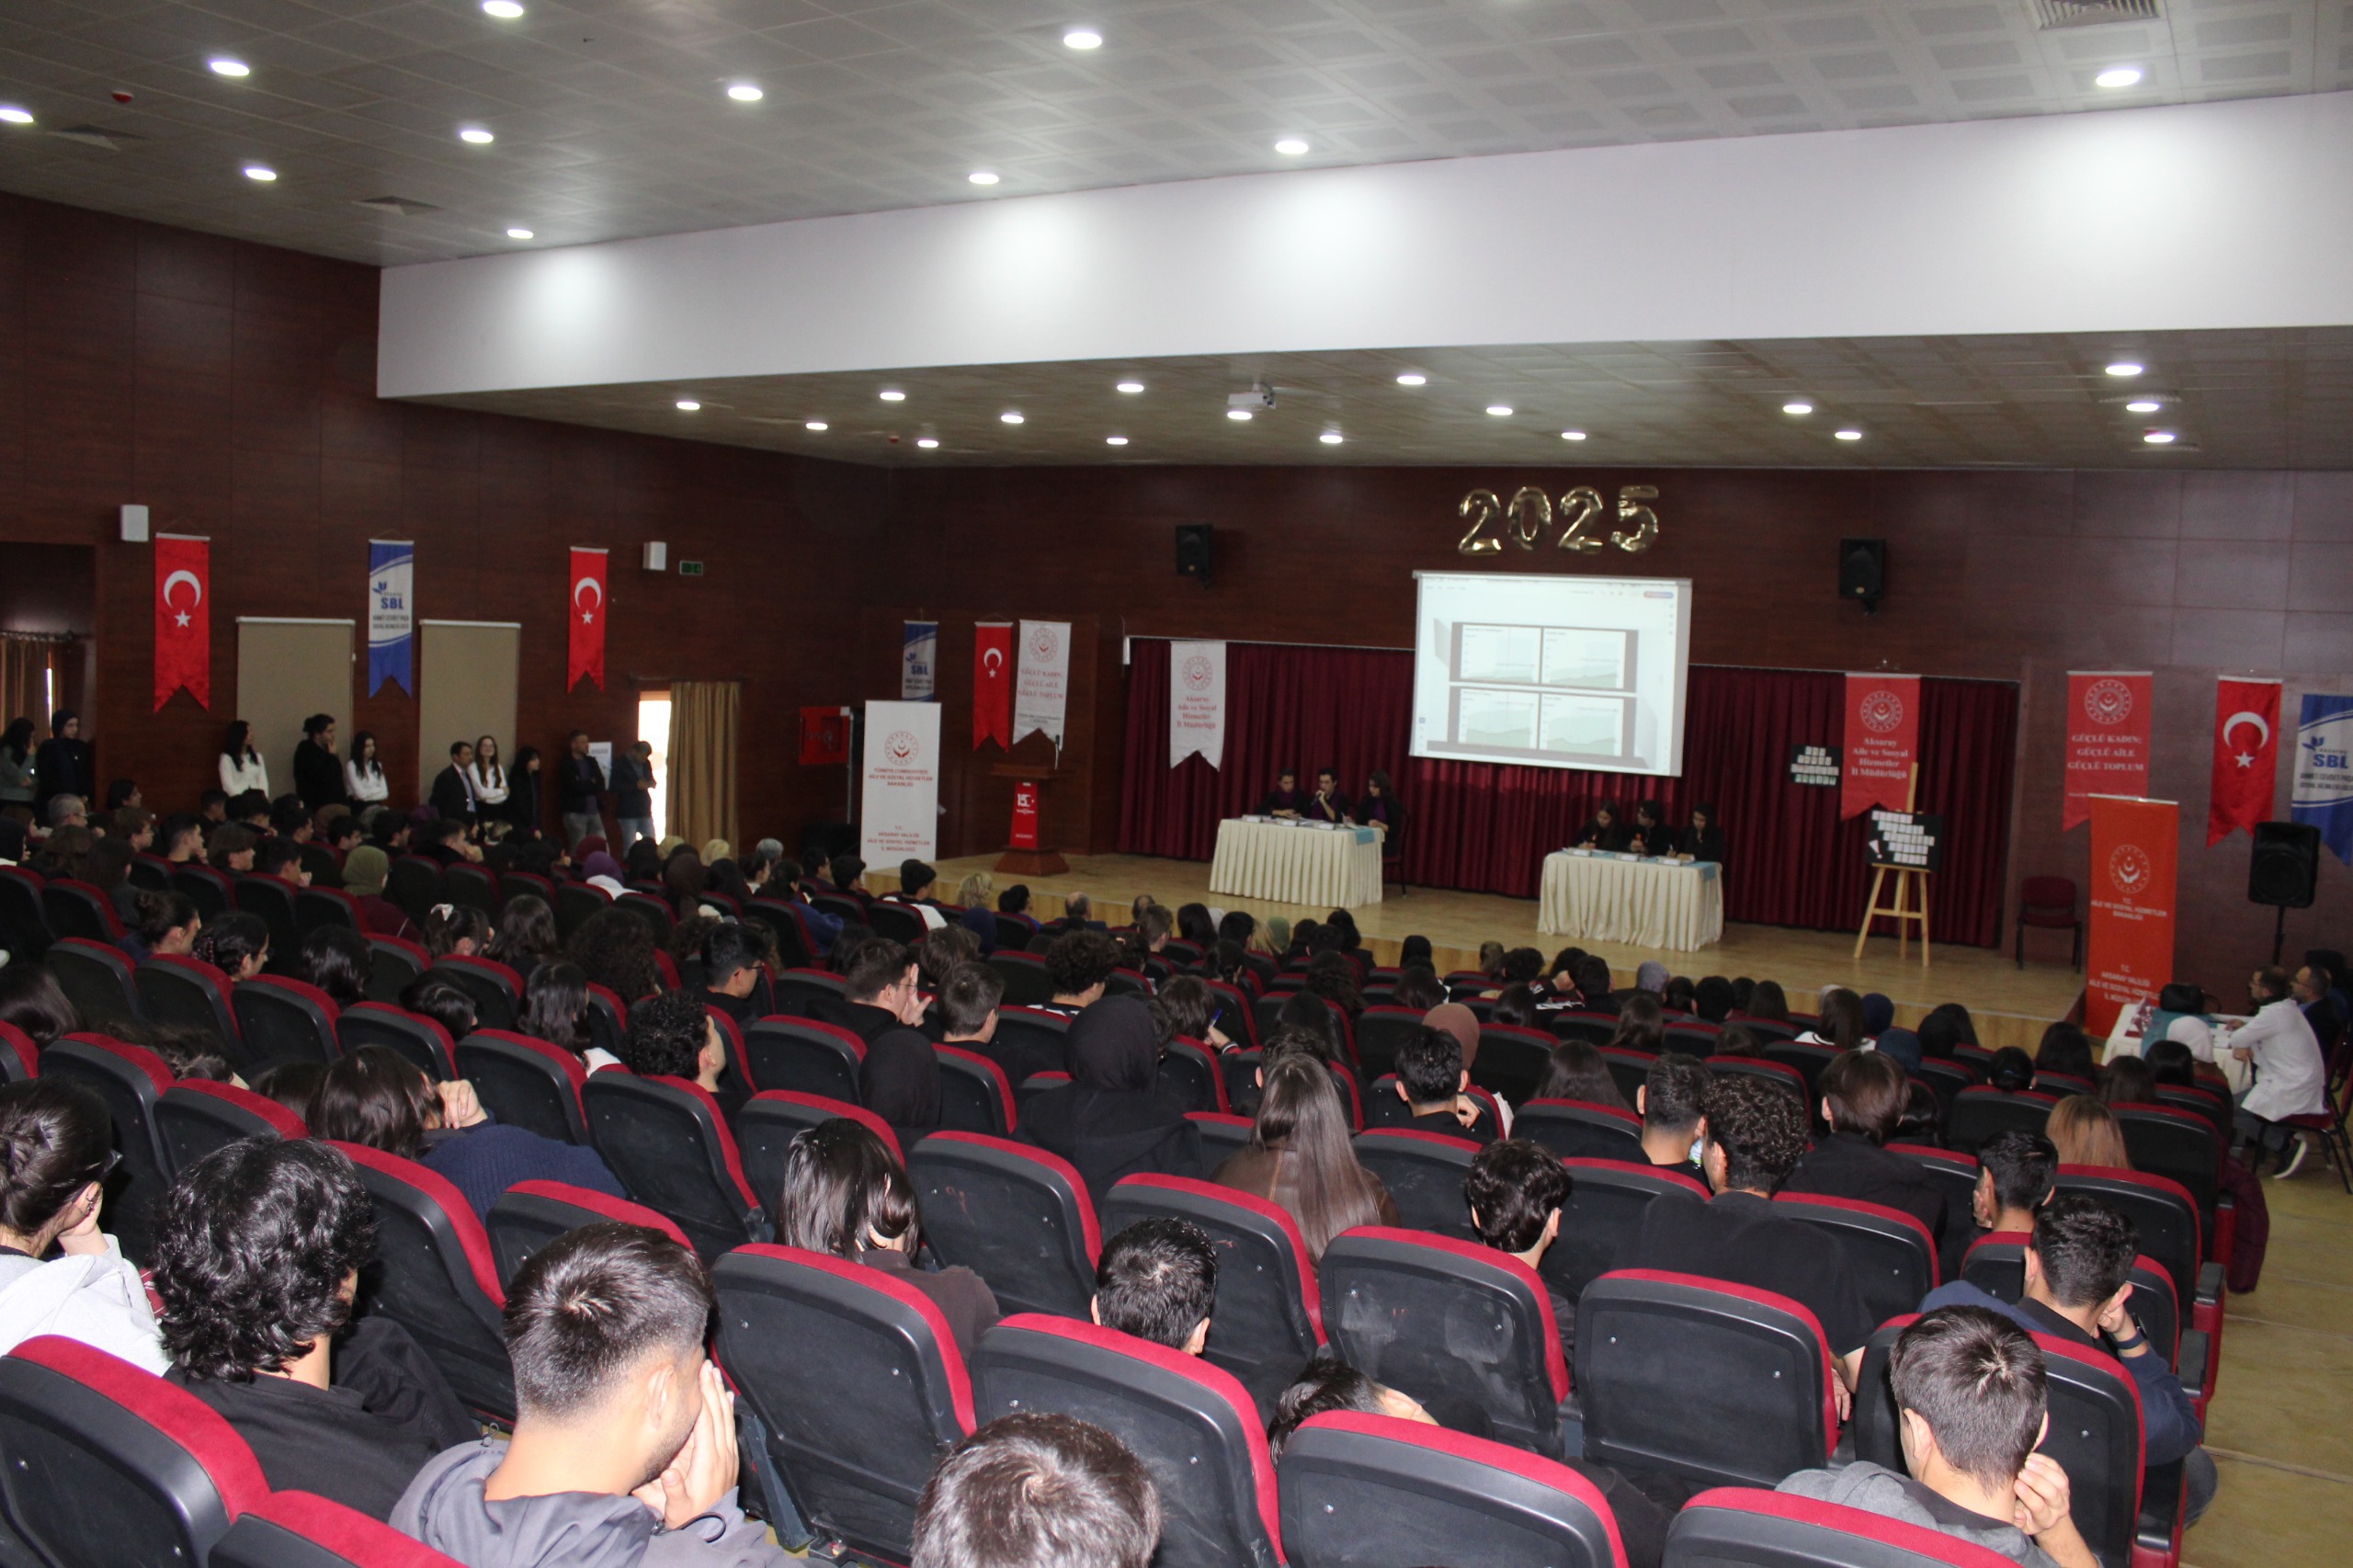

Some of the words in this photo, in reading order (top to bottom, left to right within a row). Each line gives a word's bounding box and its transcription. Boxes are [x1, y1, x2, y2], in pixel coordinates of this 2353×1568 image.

[1458, 485, 1659, 555] 2025
[381, 597, 404, 610] SBL
[911, 665, 928, 676] SBL
[1864, 737, 1898, 748] Aksaray
[2071, 733, 2105, 744] GÜÇLÜ
[1853, 747, 1868, 756] Aile
[1881, 748, 1909, 759] Sosyal
[2076, 746, 2110, 757] GÜÇLÜ
[1859, 757, 1900, 767] Hizmetler
[2067, 759, 2101, 770] GÜÇLÜ
[2103, 762, 2144, 771] TOPLUM
[2313, 754, 2349, 769] SBL
[1859, 767, 1907, 779] Müdürlüğü
